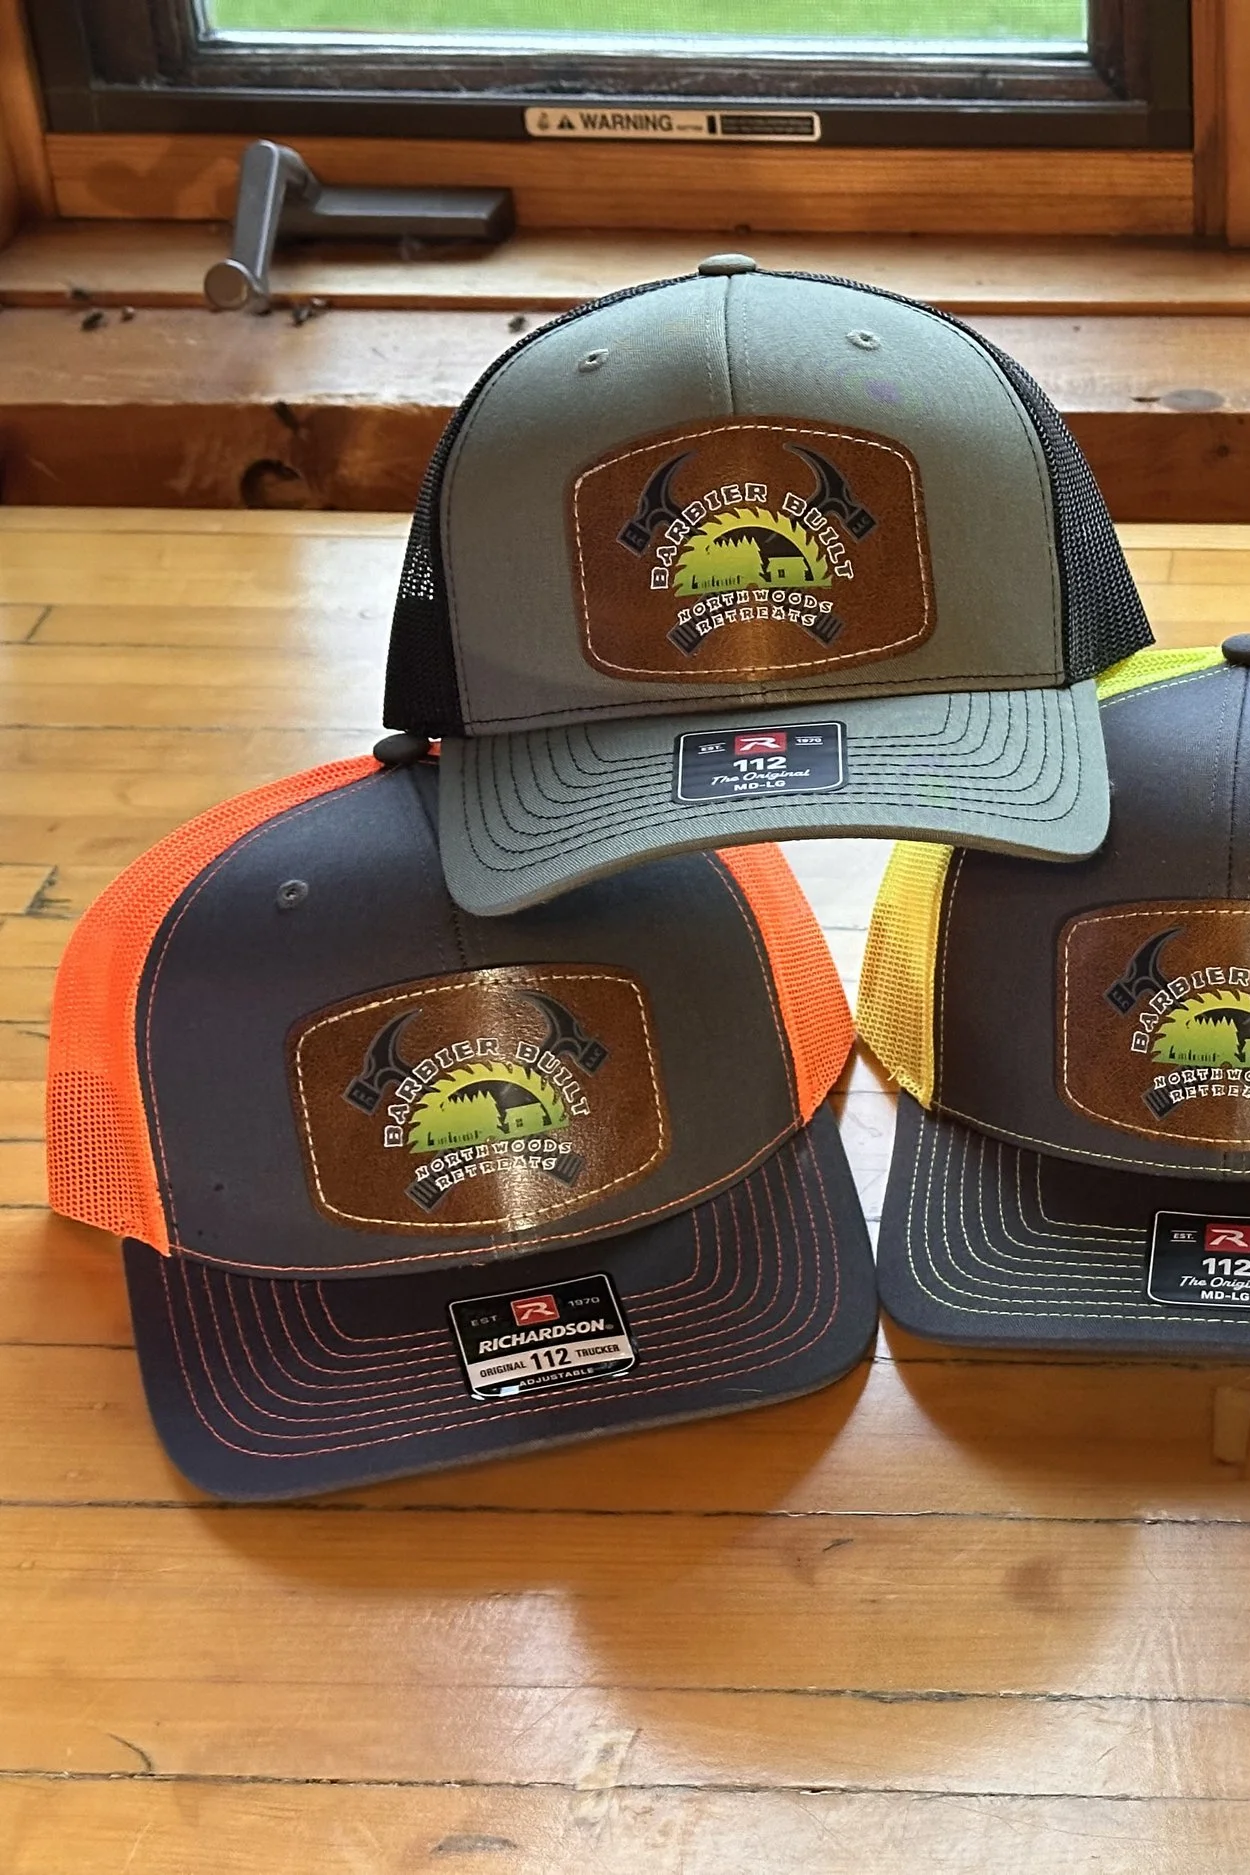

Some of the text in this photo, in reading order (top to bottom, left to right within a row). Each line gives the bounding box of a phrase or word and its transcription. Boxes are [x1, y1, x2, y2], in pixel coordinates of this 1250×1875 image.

[579, 112, 673, 131] WARNING
[650, 482, 854, 590] BARBIER BUILT
[695, 605, 817, 636] RETREATS
[733, 756, 787, 772] 112
[711, 769, 810, 786] The Original
[733, 780, 786, 792] MD-LG
[1131, 966, 1250, 1054] BARBIER
[383, 1037, 591, 1149] BARBIER BUILT
[435, 1156, 558, 1191] RETREATS
[1179, 1275, 1207, 1287] The
[567, 1296, 600, 1308] 1970
[1200, 1290, 1250, 1301] MD-LG
[479, 1343, 620, 1378] ORIGINAL 112 TRUCKER
[518, 1366, 596, 1388] ADJUSTABLE
